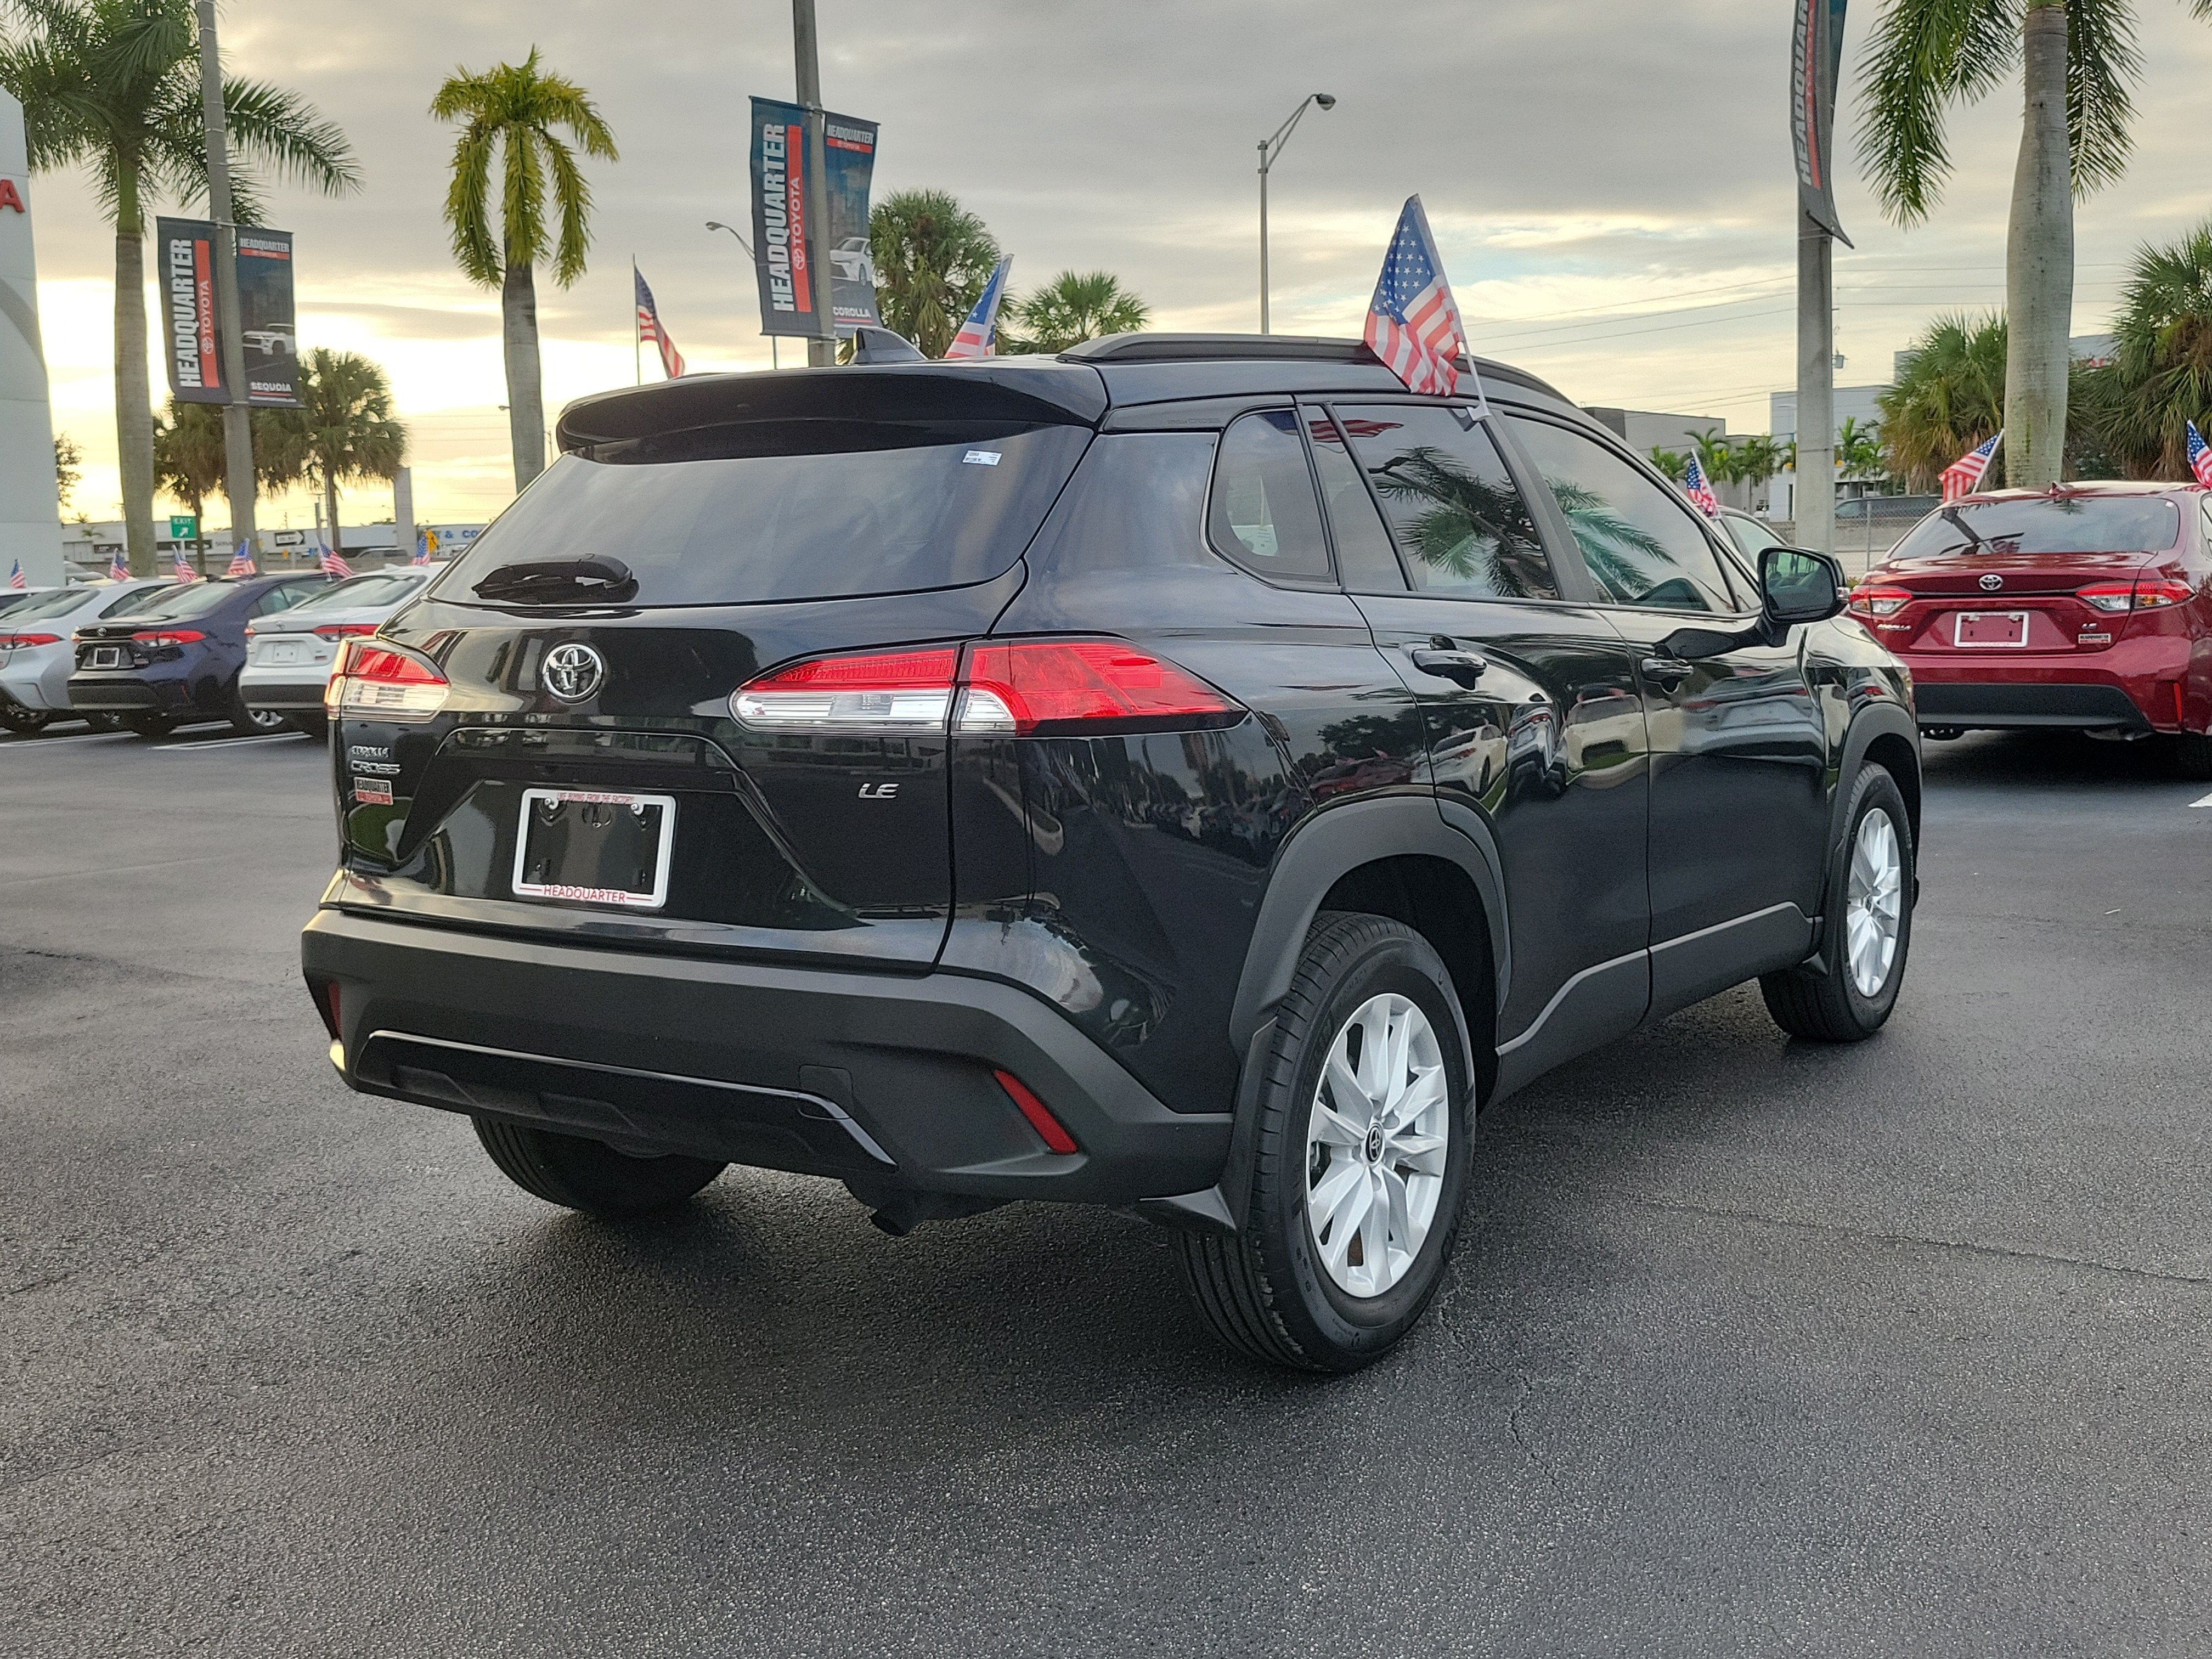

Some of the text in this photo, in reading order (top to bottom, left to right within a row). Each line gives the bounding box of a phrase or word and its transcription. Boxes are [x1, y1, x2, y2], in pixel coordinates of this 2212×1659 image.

[827, 125, 873, 144] HEADQUARTER
[763, 123, 794, 312] HEADQUARTER
[789, 177, 805, 247] TOYOTA
[240, 238, 290, 253] HEADQUARTER
[170, 239, 202, 387] HEADQUARTER
[199, 280, 211, 334] TOYOTA
[833, 307, 872, 318] COROLLA
[250, 381, 292, 392] SEQUOIA
[445, 531, 454, 539] &
[858, 783, 900, 798] LE
[544, 885, 626, 902] HEADQUARTER
